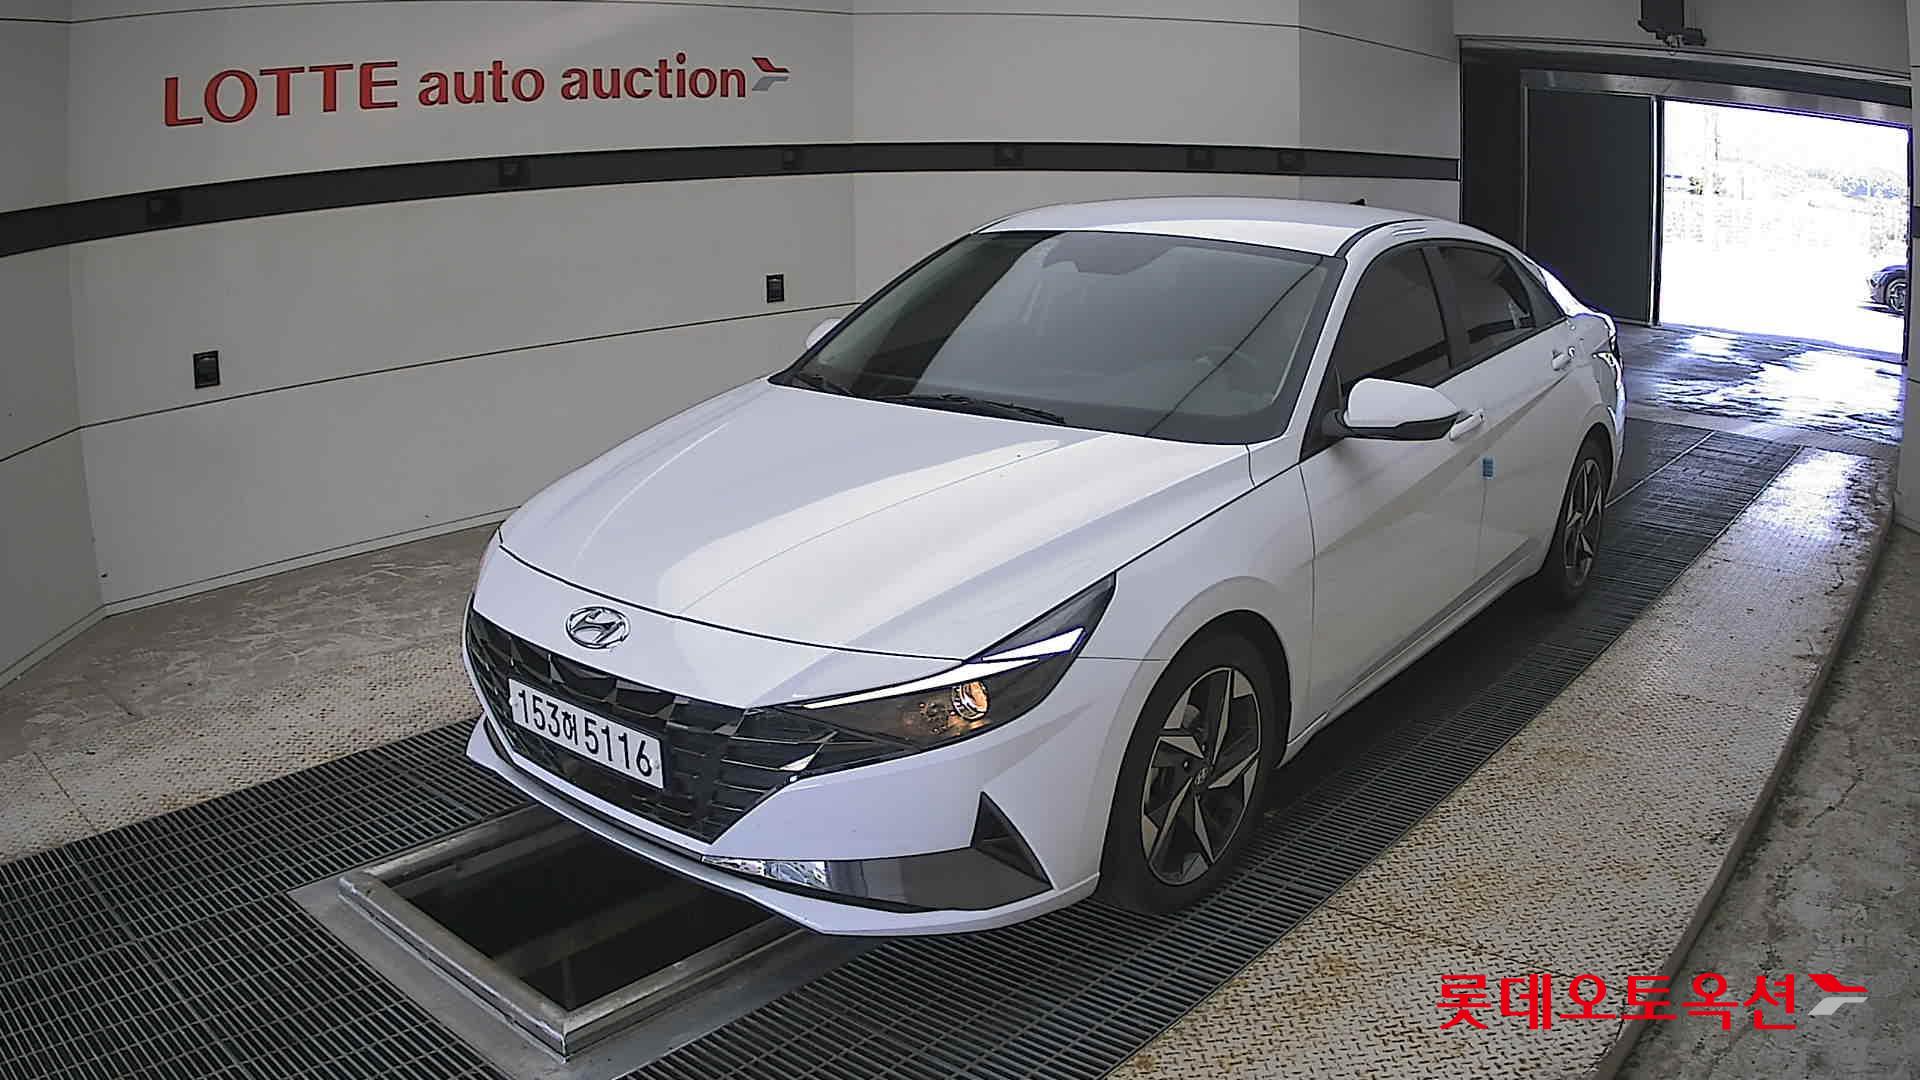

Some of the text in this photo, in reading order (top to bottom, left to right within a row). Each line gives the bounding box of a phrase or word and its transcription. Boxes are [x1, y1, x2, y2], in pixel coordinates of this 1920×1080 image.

[164, 52, 747, 126] LOTTE auto auction
